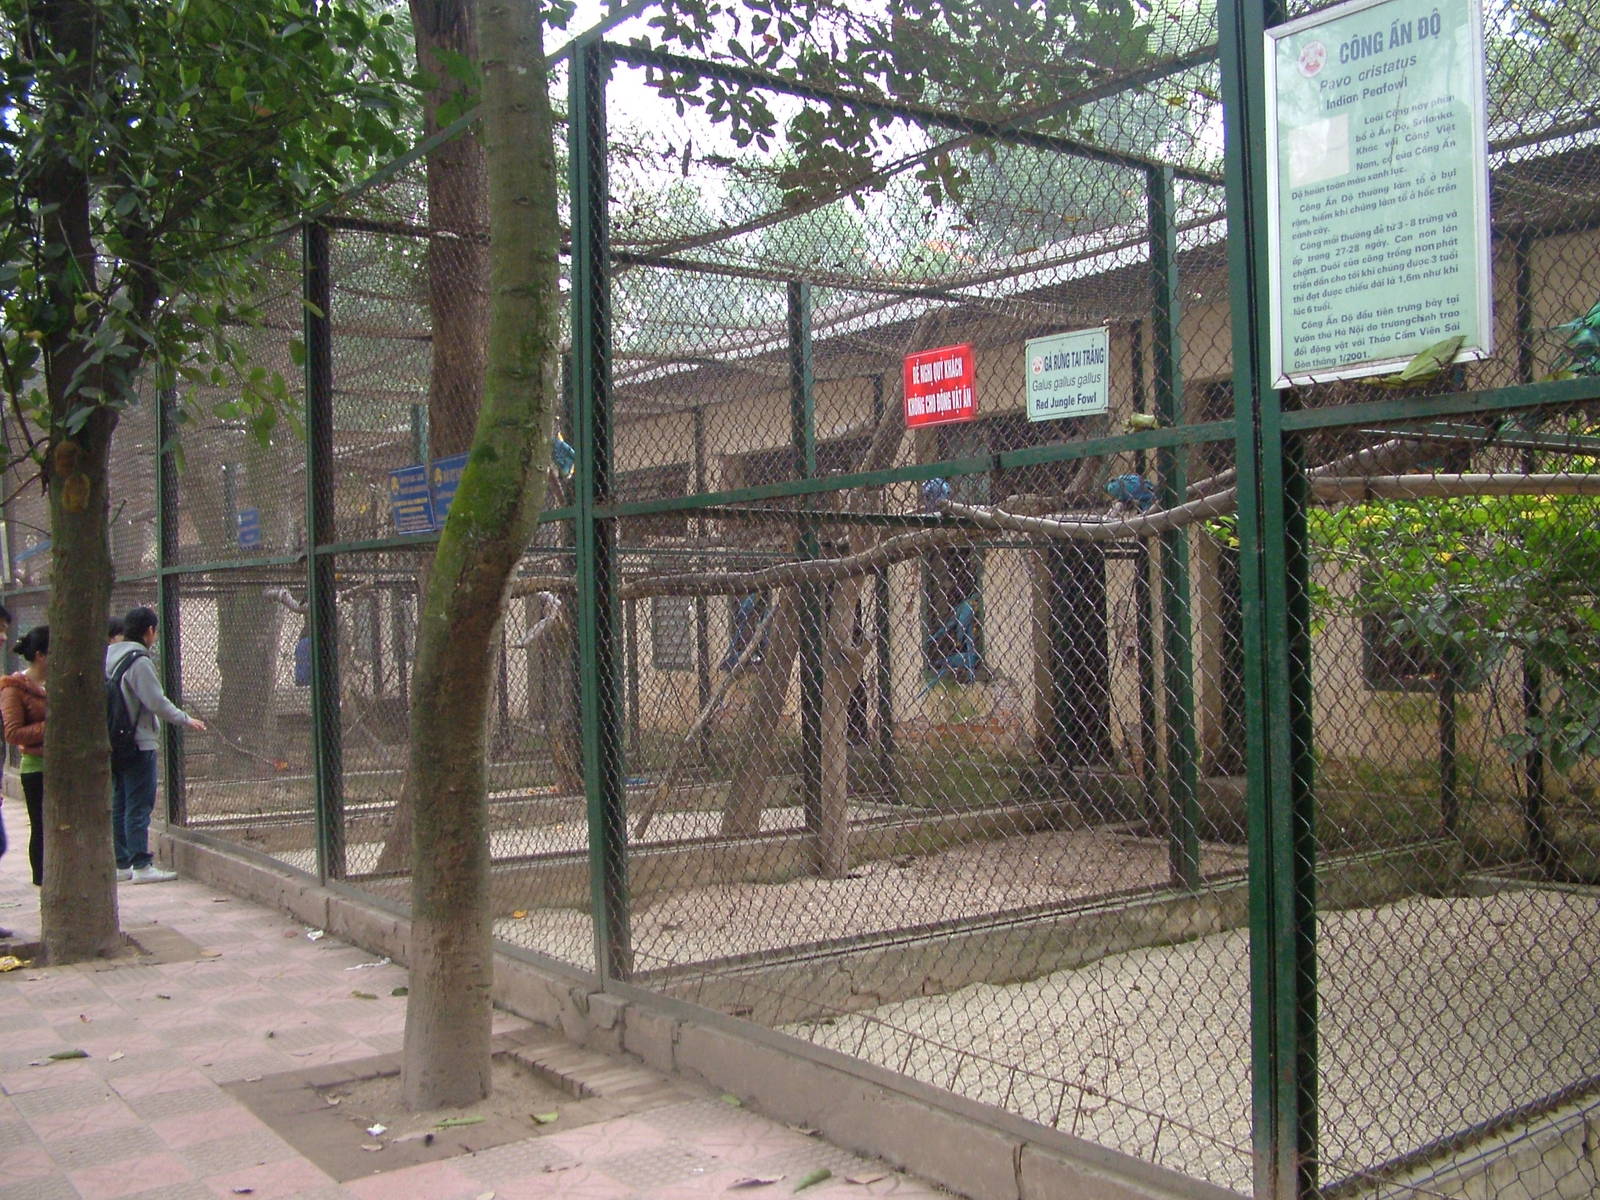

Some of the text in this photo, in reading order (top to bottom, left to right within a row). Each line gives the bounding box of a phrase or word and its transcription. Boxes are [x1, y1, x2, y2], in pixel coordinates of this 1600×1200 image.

[1339, 8, 1441, 64] CÔNG ẤN ĐỘ
[1320, 55, 1417, 92] Pavo cristatus
[1326, 78, 1408, 111] Indian Peafowl
[1436, 123, 1456, 134] Việt
[1397, 221, 1403, 230] 3
[1410, 218, 1416, 227] 8
[1308, 252, 1330, 262] trong
[1394, 234, 1413, 244] Con
[1418, 230, 1437, 239] non
[1415, 244, 1435, 253] non
[1331, 275, 1346, 284] cho
[1361, 268, 1375, 277] khi
[1431, 255, 1437, 264] 3
[1443, 264, 1458, 275] khi
[1307, 305, 1312, 314] 6
[1366, 323, 1378, 332] do
[1439, 310, 1460, 319] trao
[1071, 351, 1082, 367] TAI
[1077, 372, 1101, 388] gallus
[1036, 392, 1097, 410] Red Jungle Fowl
